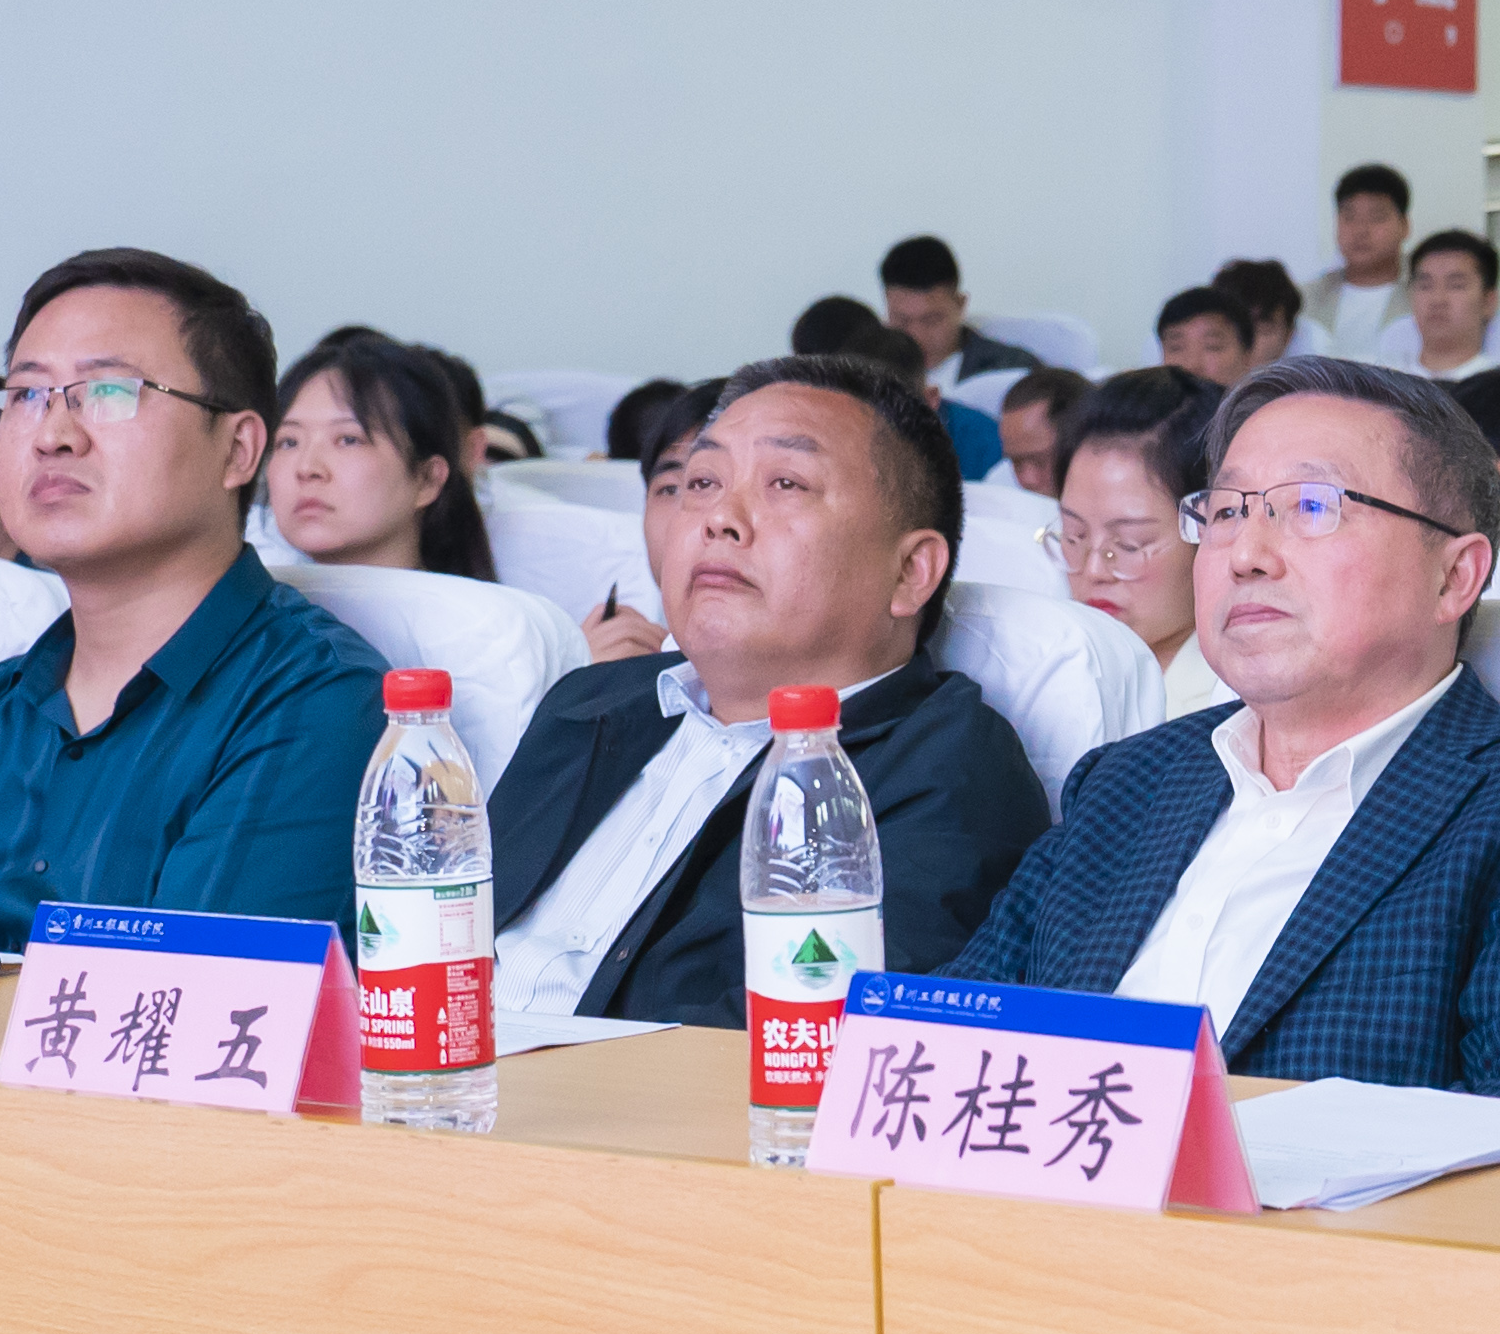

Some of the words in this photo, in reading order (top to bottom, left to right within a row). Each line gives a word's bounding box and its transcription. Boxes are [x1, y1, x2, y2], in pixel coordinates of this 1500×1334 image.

[25, 971, 268, 1091] 黄耀五
[371, 1019, 415, 1035] SPRING
[763, 1051, 818, 1068] NONGFU
[850, 1041, 1143, 1181] 陈桂秀
